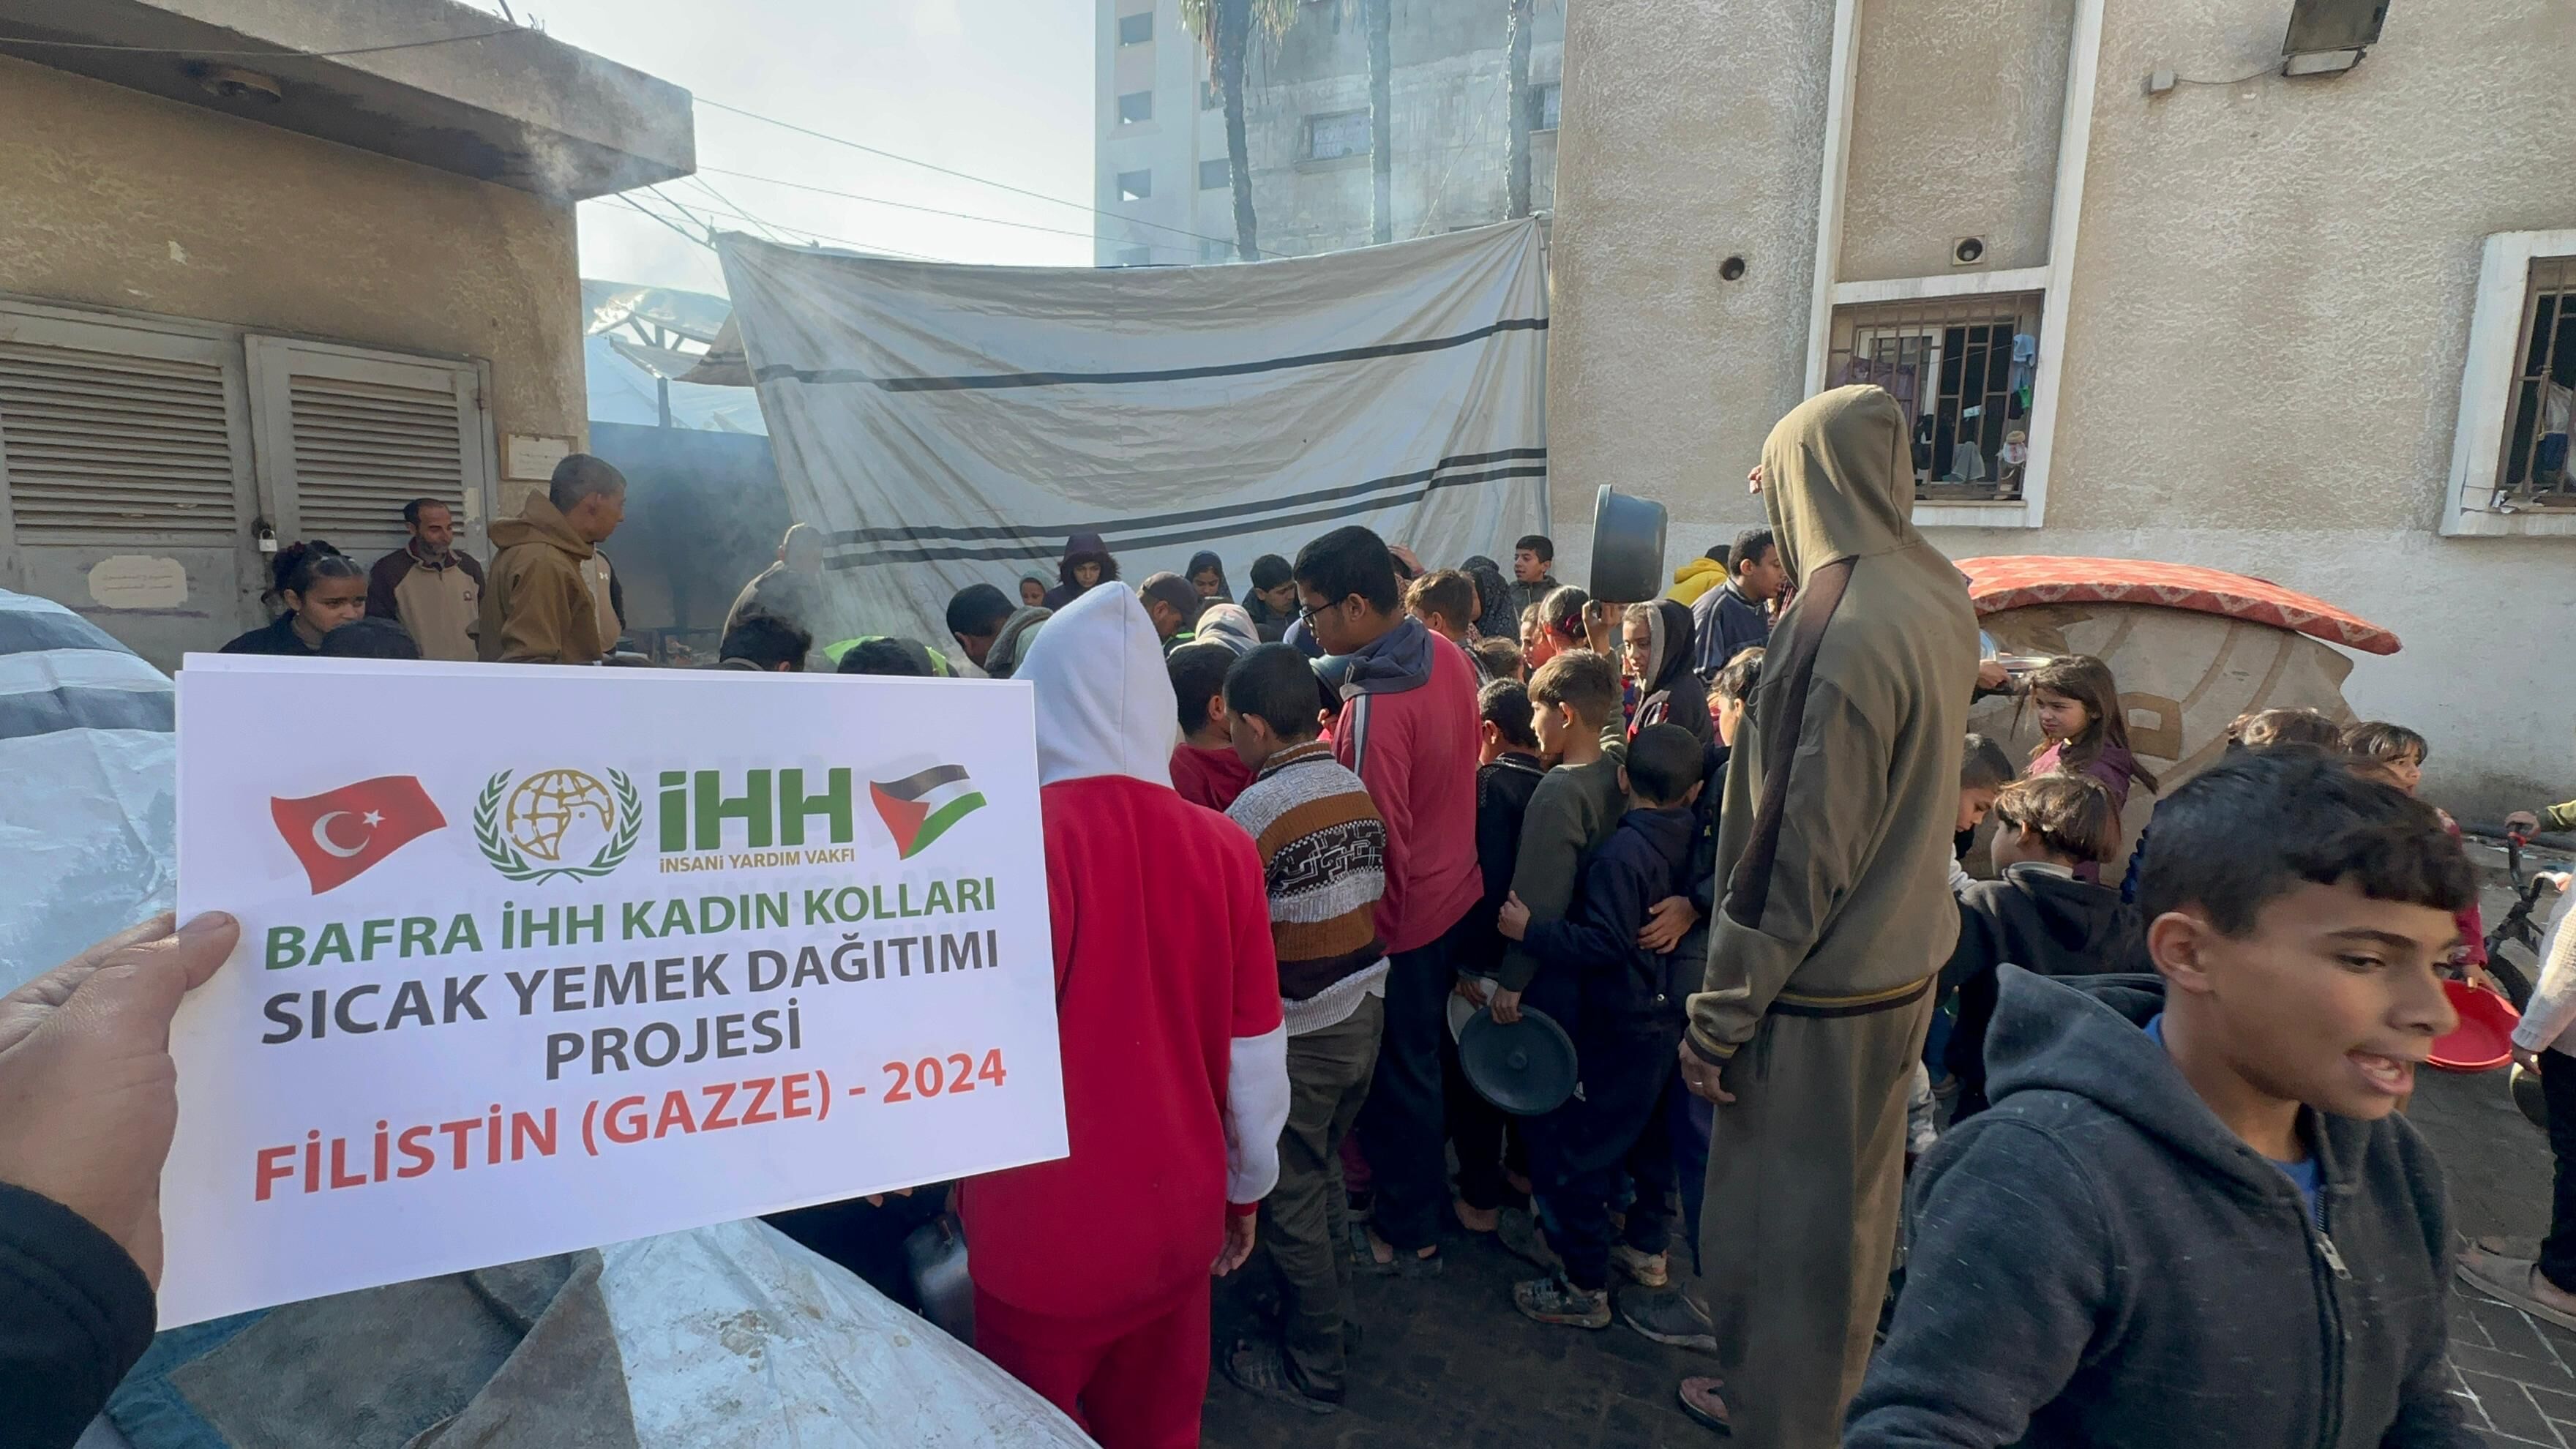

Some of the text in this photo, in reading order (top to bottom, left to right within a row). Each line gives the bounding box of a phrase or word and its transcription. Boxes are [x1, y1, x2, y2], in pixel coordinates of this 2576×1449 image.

[729, 850, 801, 869] YARDIM
[804, 847, 855, 864] VAKFI
[265, 877, 995, 970] BAFRA İHH KADIN KOLLARI
[261, 929, 997, 1044] SICAK YEMEK DAĞITIMI
[546, 997, 801, 1081] PROJESİ
[255, 1049, 1007, 1202] FİLİSTİN (GAZZE) - 2024
